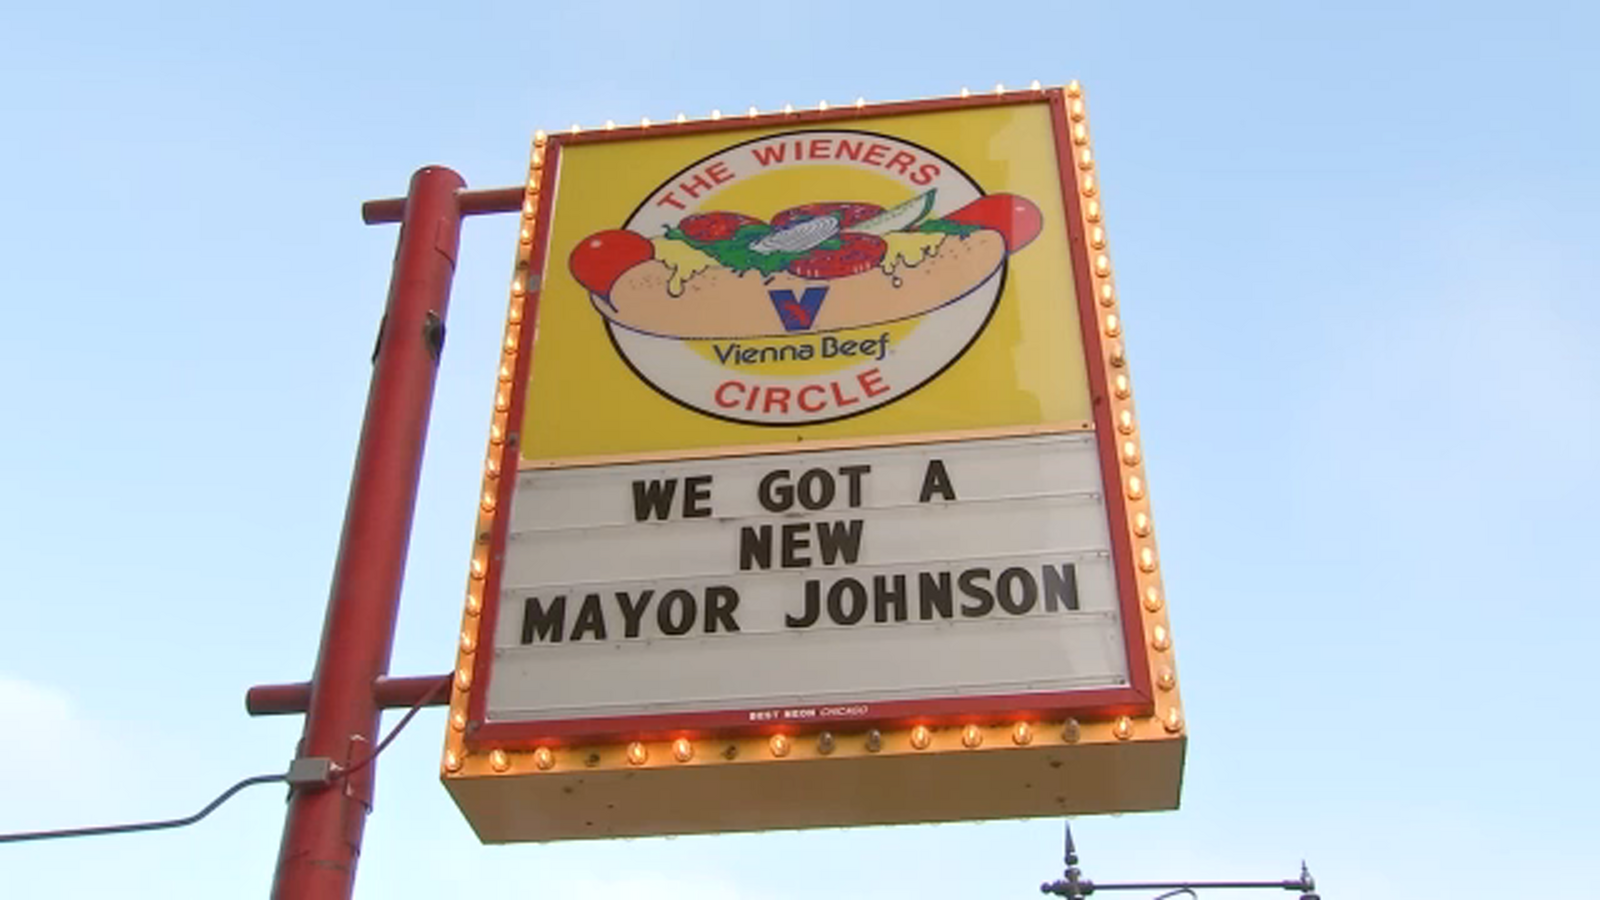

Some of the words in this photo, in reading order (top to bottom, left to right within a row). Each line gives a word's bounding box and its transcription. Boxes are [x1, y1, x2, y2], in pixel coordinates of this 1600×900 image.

[657, 161, 736, 211] THE
[752, 139, 941, 187] WIENERS
[713, 342, 815, 366] Vienna
[821, 332, 890, 361] Beef
[714, 368, 891, 414] CIRCLE
[632, 475, 713, 522] WE
[758, 465, 872, 513] GOT
[919, 459, 956, 502] A
[739, 520, 864, 570] NEW
[521, 585, 740, 645] MAYOR
[785, 563, 1080, 628] JOHNSON
[749, 710, 780, 721] BEST
[784, 708, 816, 719] NEON
[820, 704, 869, 717] CHICAGO
